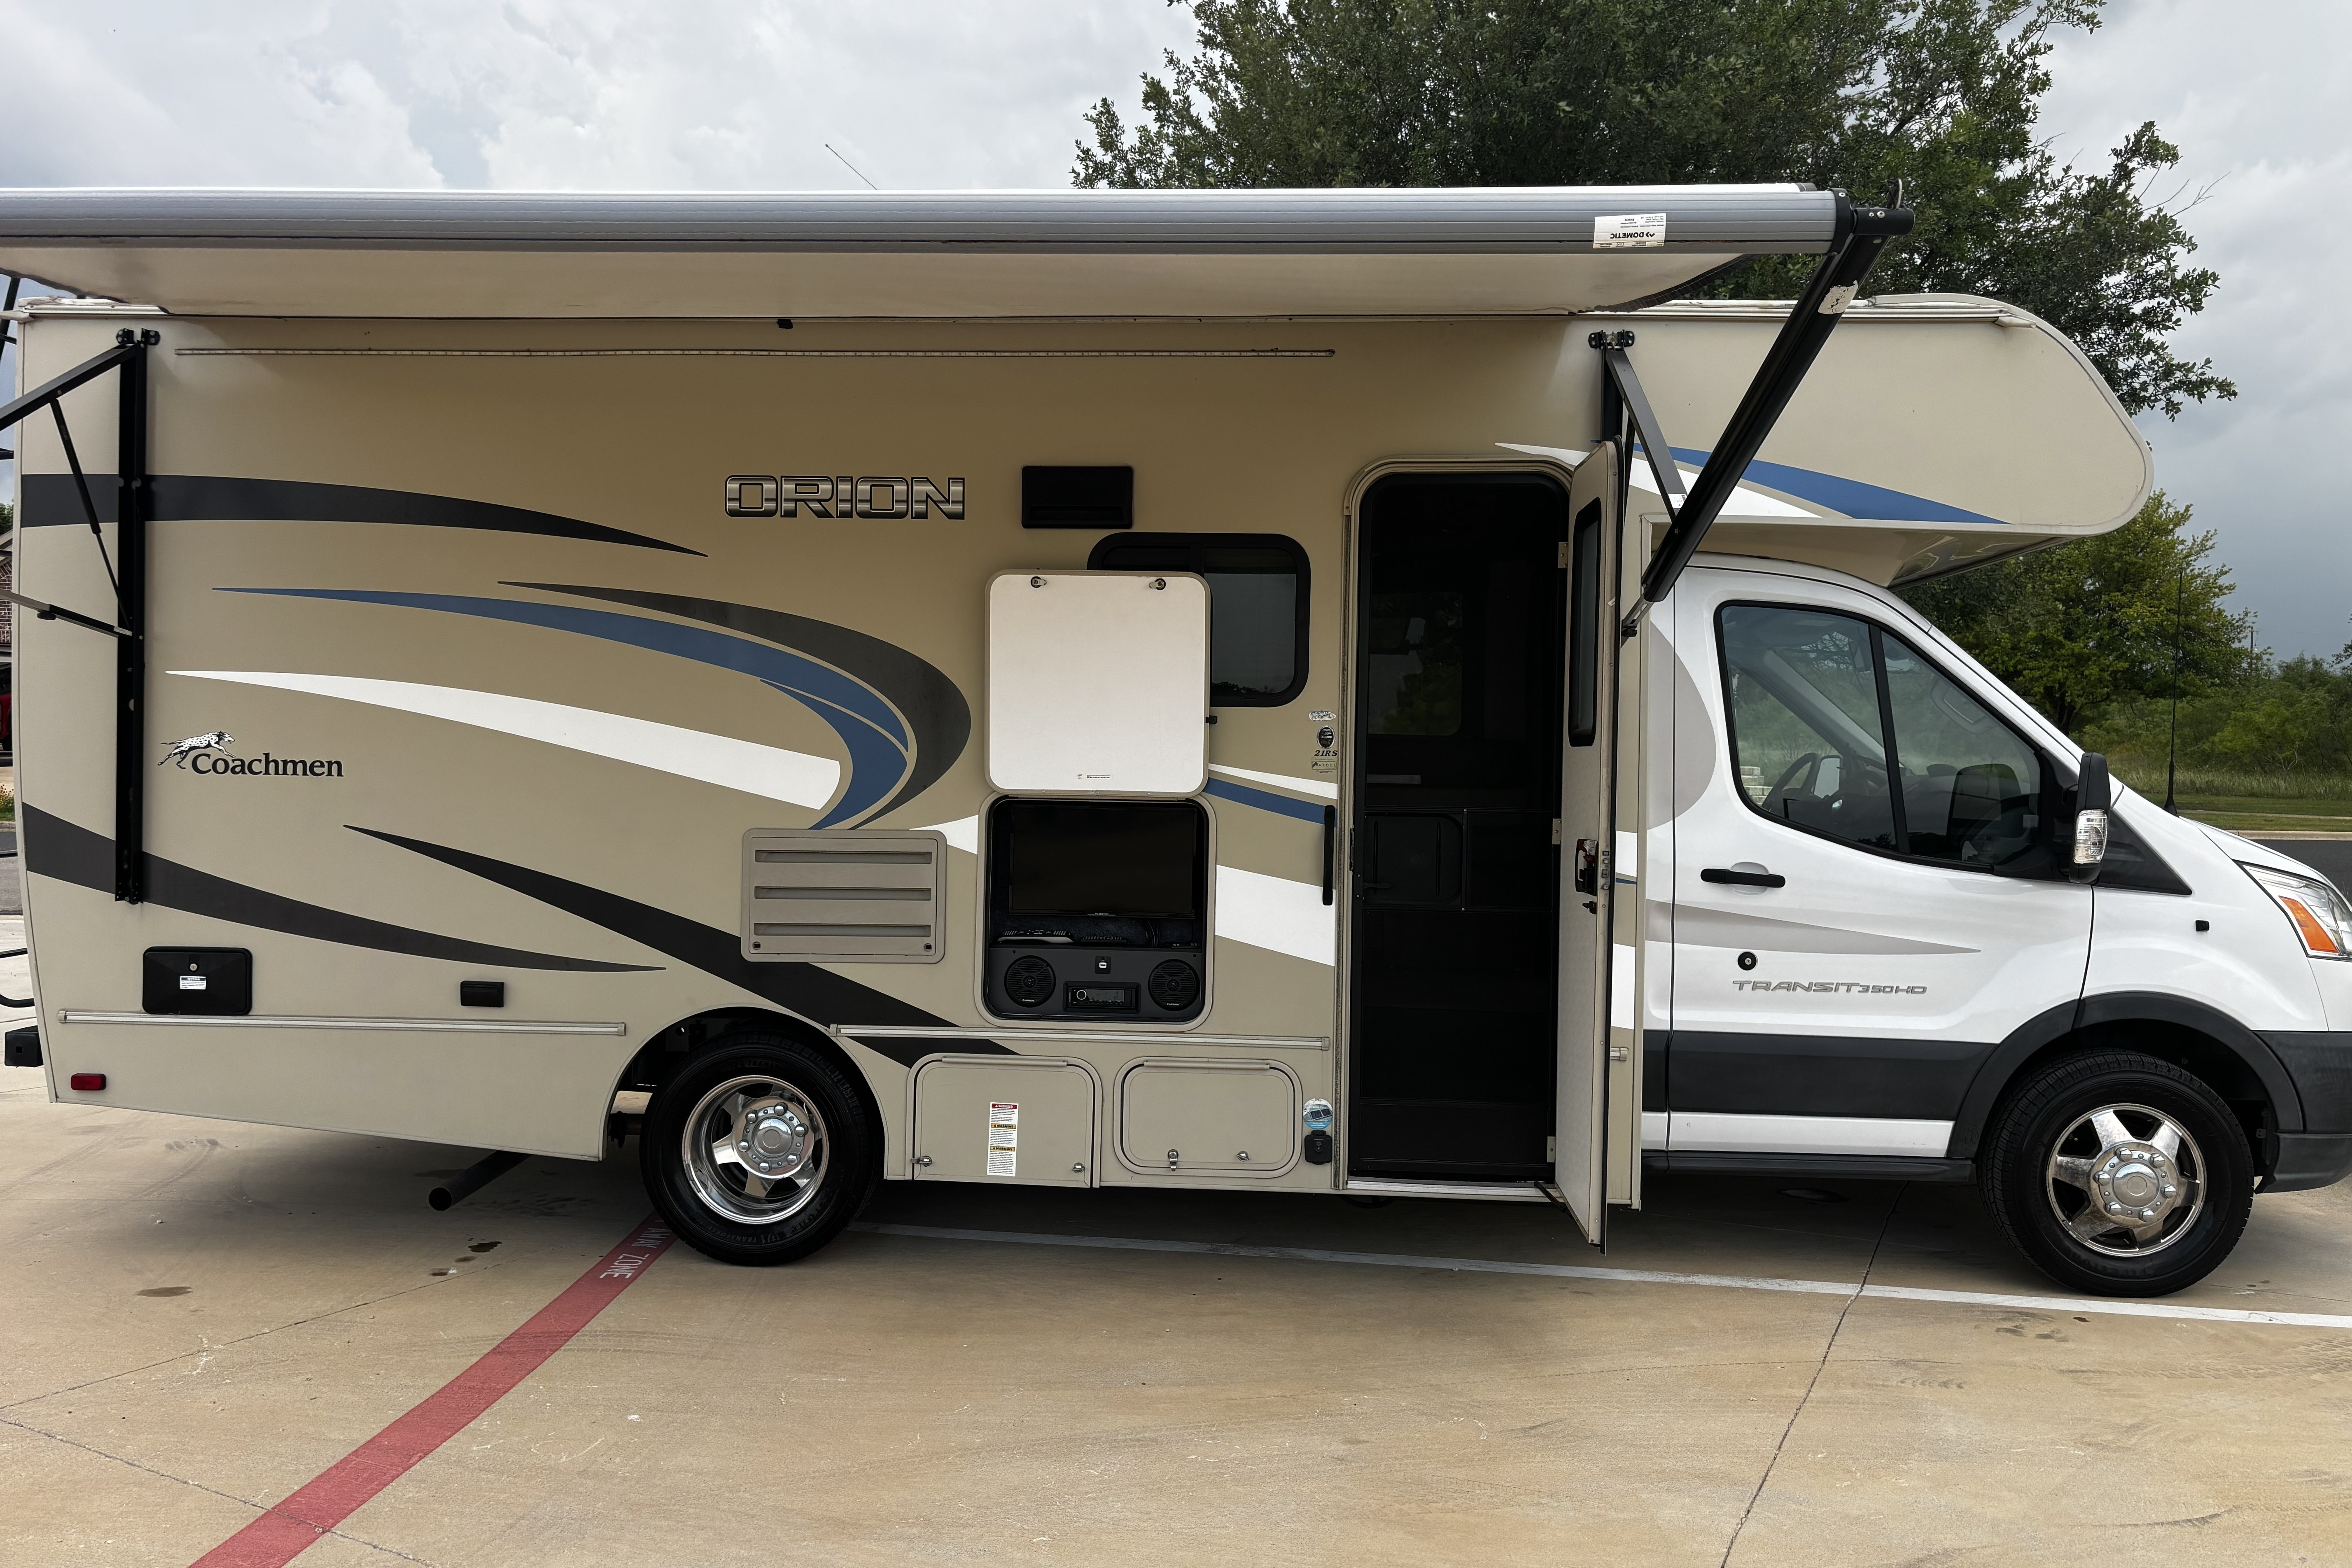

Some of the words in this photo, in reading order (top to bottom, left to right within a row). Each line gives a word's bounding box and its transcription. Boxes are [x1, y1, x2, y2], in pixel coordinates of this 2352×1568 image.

[725, 475, 965, 520] ORION
[191, 752, 344, 777] Coachmen
[599, 1253, 651, 1279] ZONE
